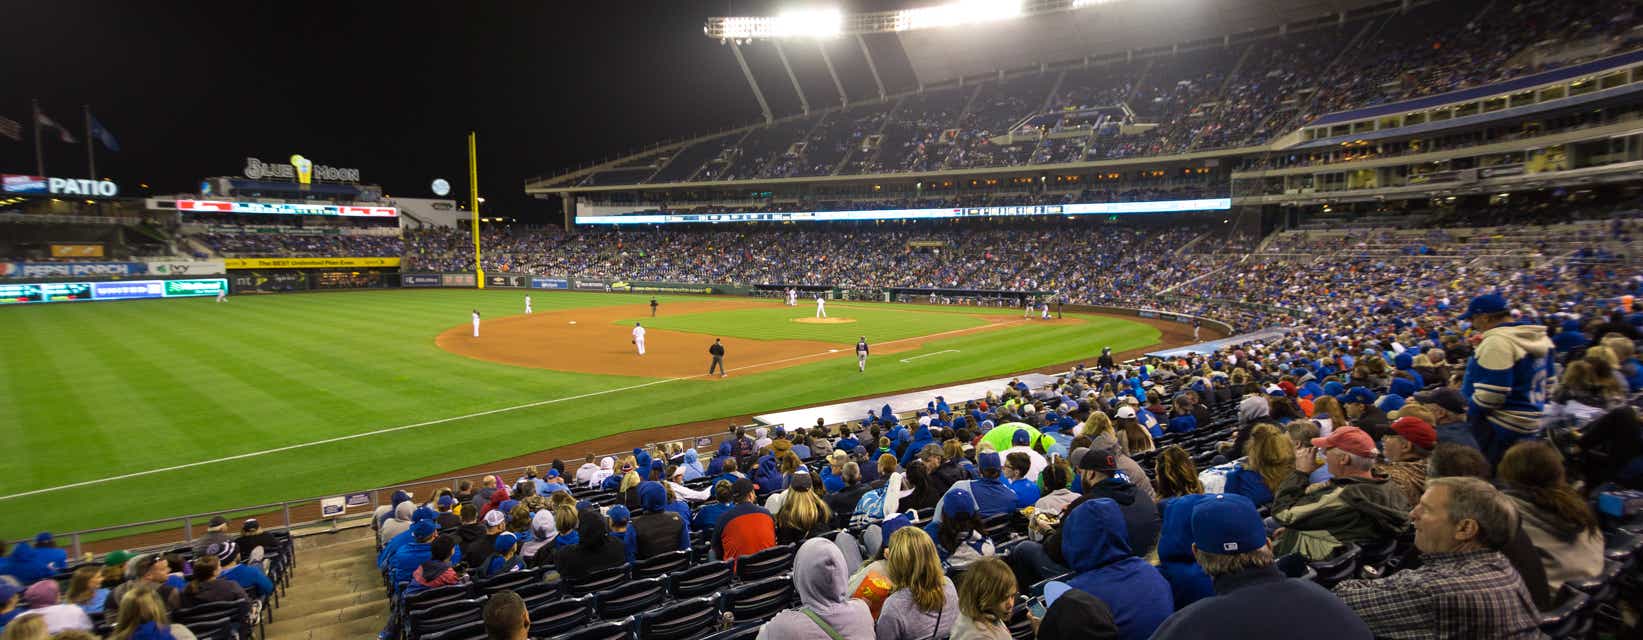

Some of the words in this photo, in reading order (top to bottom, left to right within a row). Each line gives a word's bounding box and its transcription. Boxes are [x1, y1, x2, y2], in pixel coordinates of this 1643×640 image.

[314, 165, 360, 181] MOON
[49, 178, 117, 196] PATIO
[24, 265, 70, 276] PEPSI
[74, 265, 128, 275] PORCH
